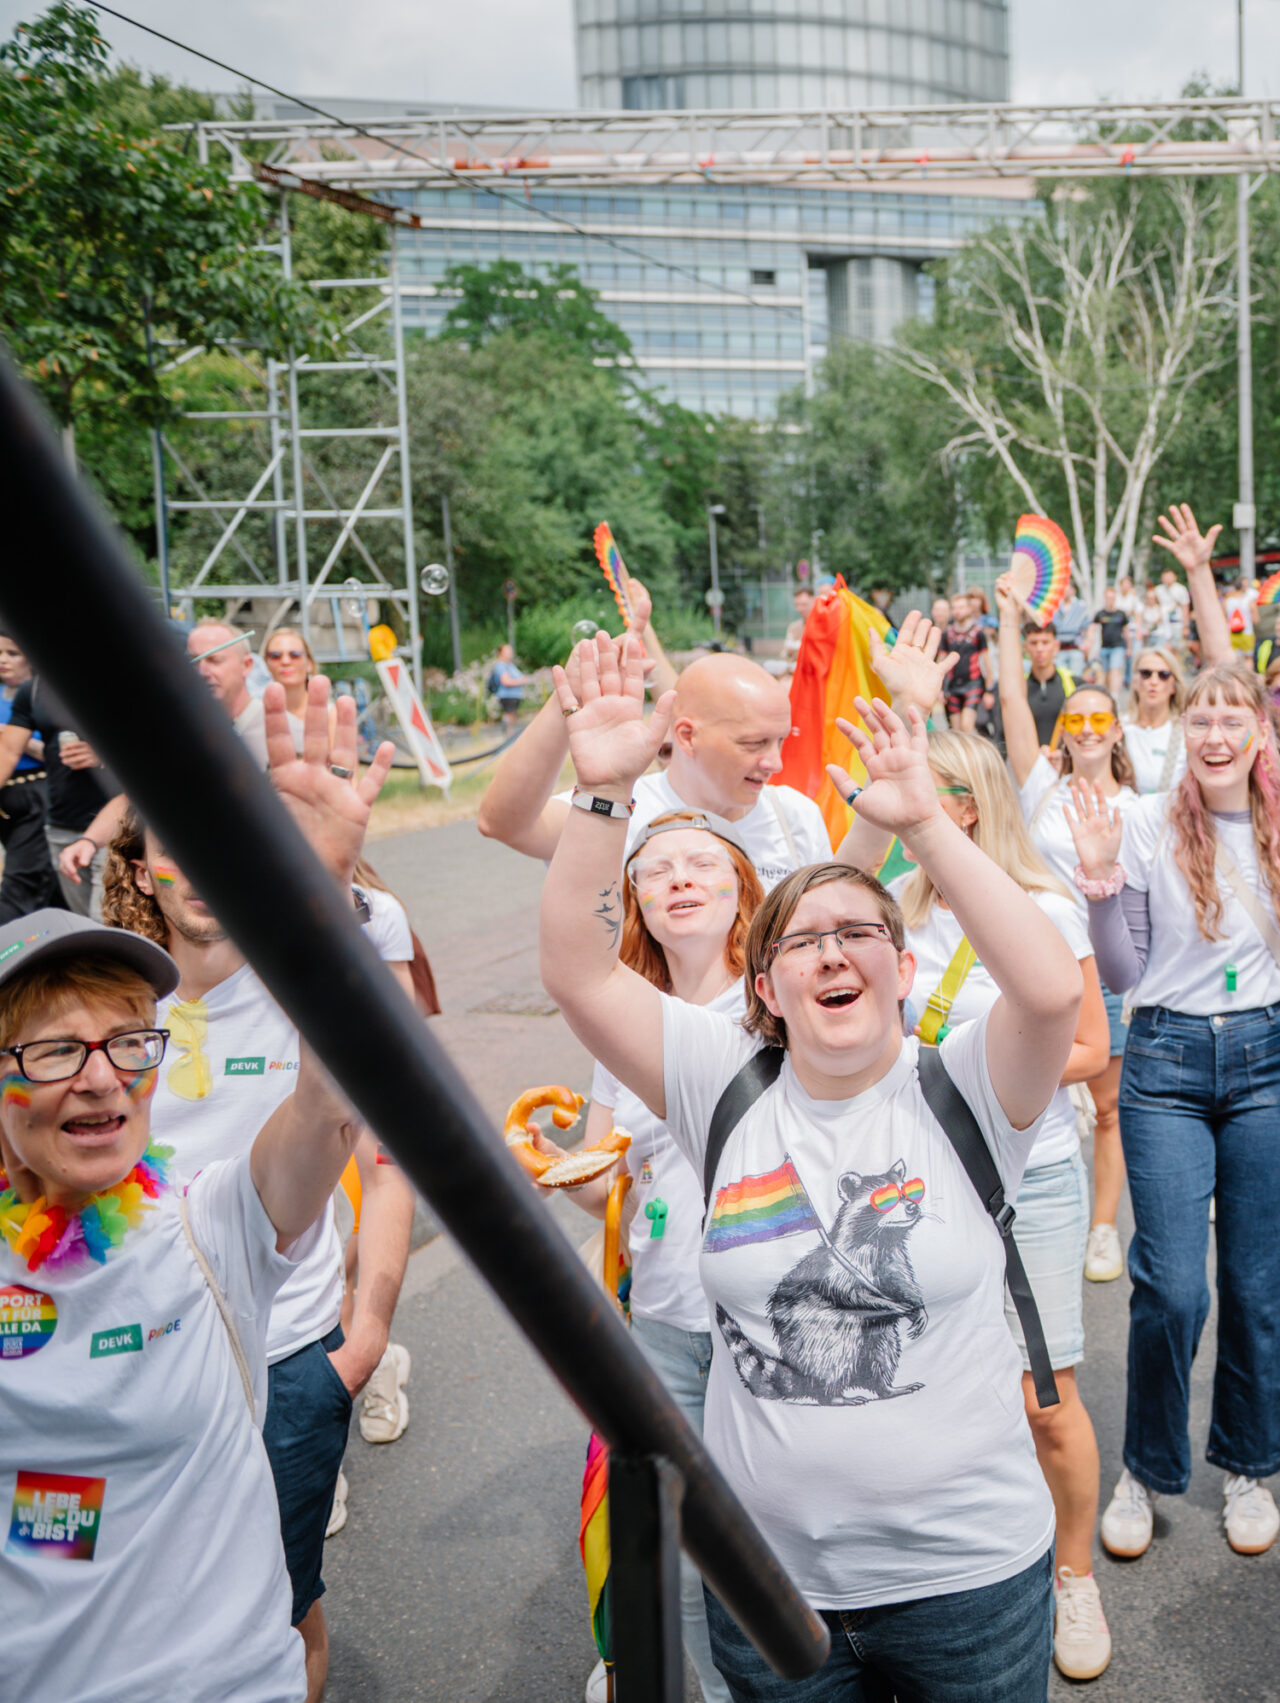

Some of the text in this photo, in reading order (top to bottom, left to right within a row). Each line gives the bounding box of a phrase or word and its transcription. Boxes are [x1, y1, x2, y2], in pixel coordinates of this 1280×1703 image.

[230, 1061, 299, 1070] DEVK PRIDE
[0, 1294, 43, 1308] PORT
[12, 1306, 42, 1321] FÜR
[0, 1321, 42, 1335] LLE DA
[99, 1319, 181, 1350] DEVK PRIDE
[33, 1491, 81, 1510] LEBE
[18, 1506, 96, 1527] WIE DU
[32, 1523, 78, 1542] BIST
